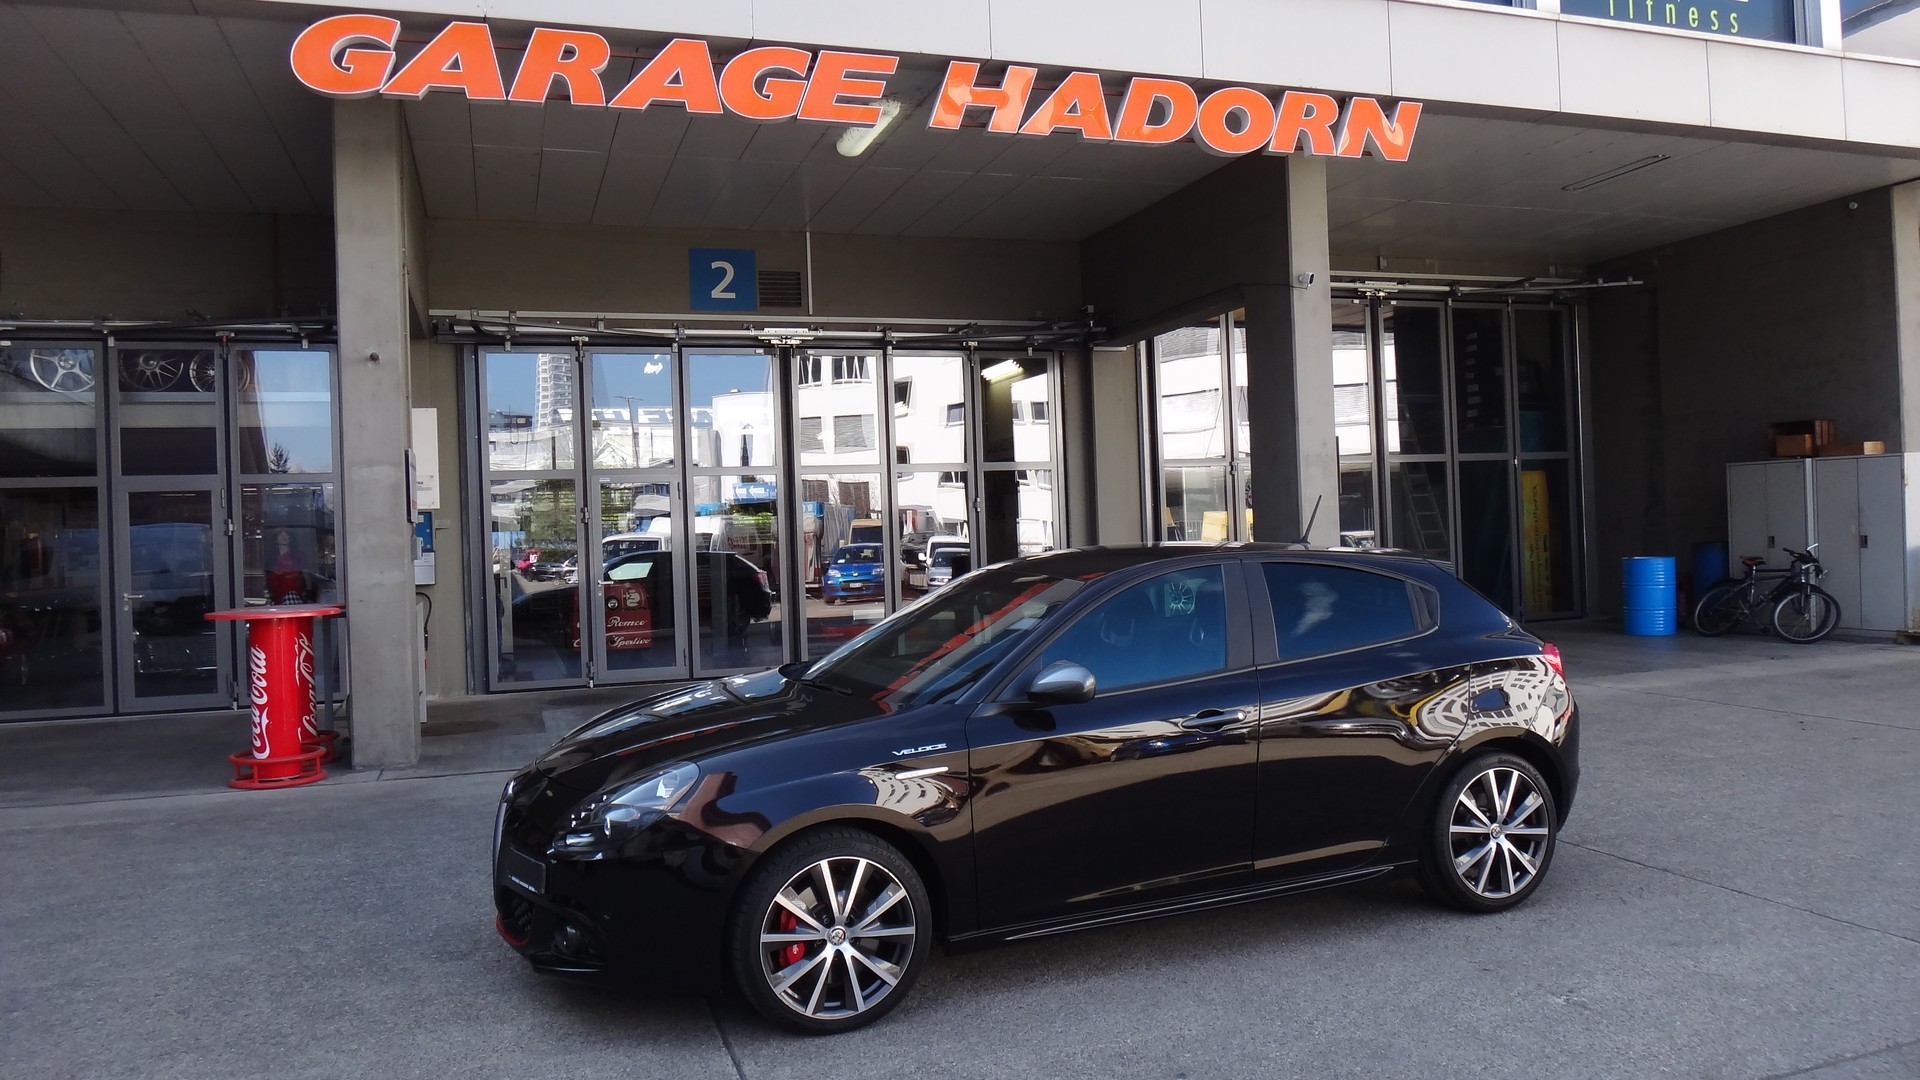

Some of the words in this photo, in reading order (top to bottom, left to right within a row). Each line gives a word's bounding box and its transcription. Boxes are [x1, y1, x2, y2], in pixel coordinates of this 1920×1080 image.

[290, 14, 900, 128] GARAGE
[928, 60, 1424, 162] HADORN
[710, 261, 736, 299] 2
[891, 743, 948, 756] VELOCE
